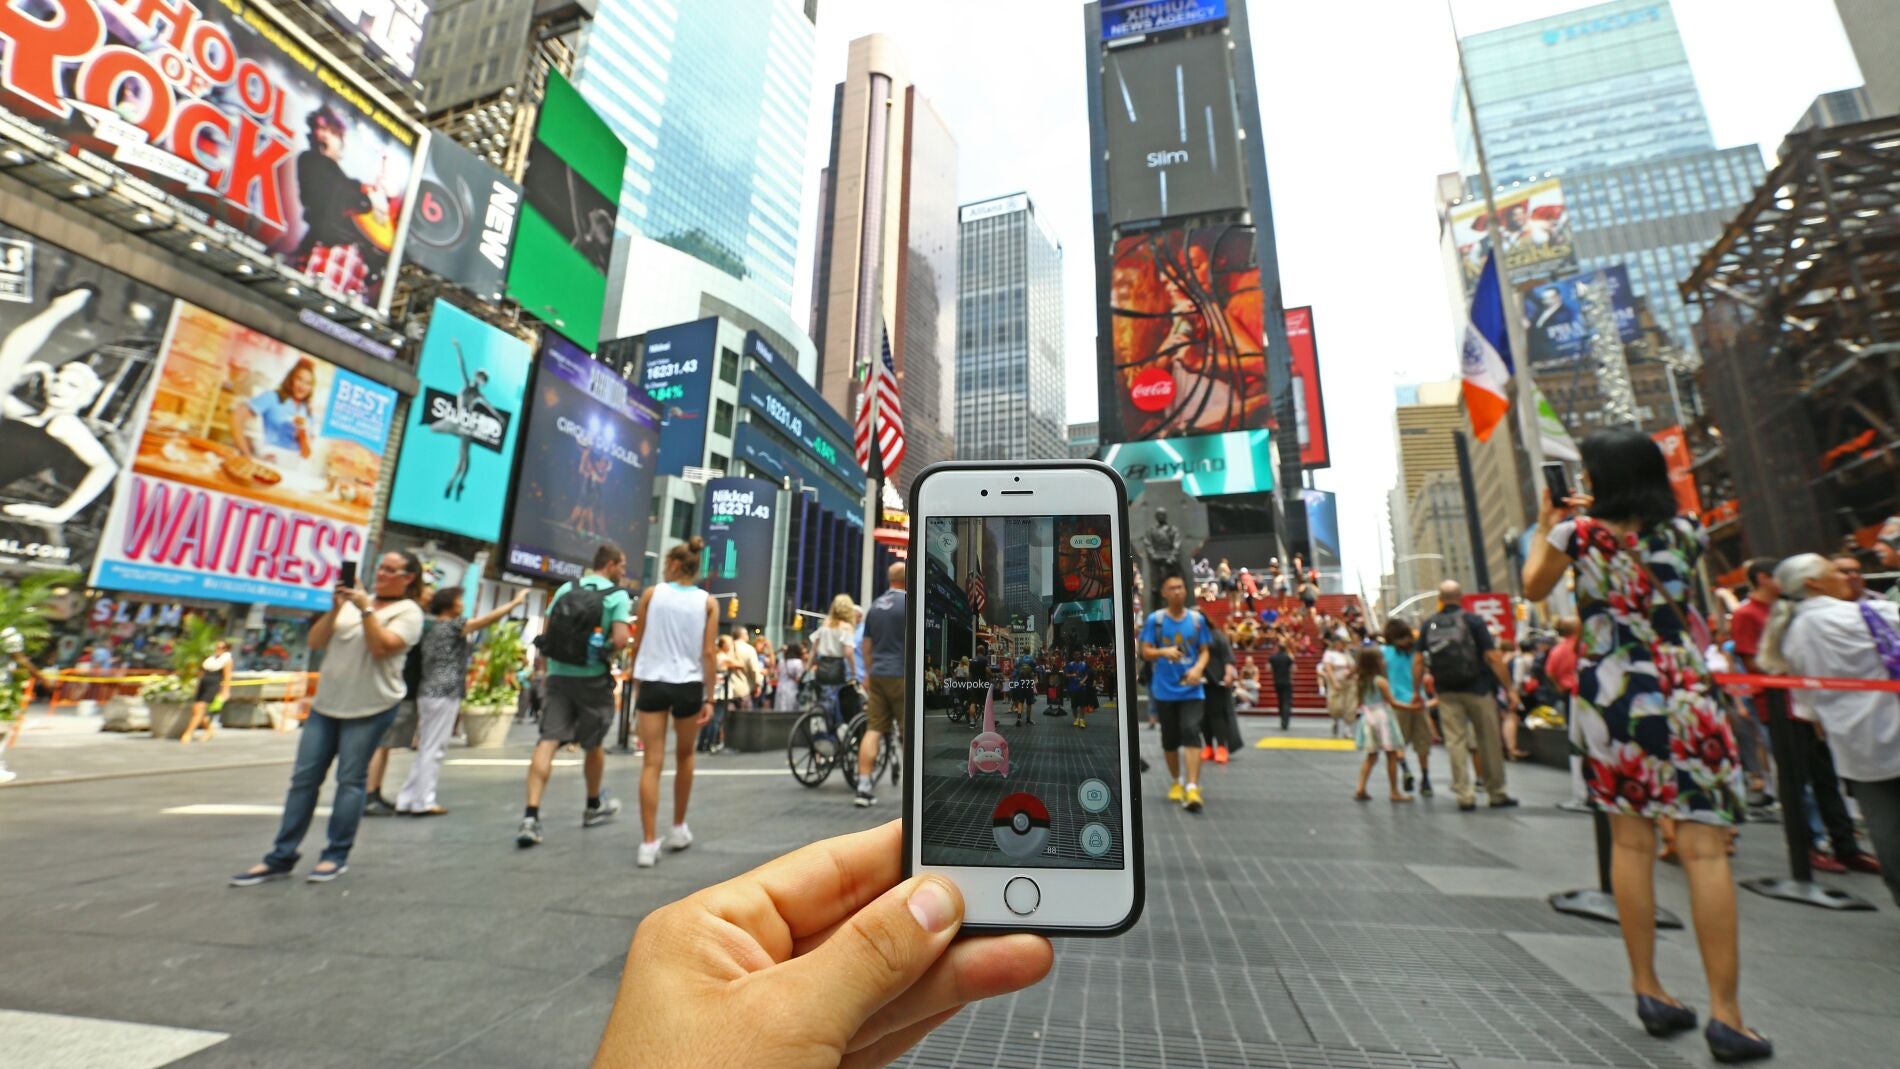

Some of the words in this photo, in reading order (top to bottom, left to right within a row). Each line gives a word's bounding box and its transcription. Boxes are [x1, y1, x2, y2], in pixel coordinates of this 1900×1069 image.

[1110, 17, 1153, 36] NEWS
[1153, 5, 1215, 28] AGENCY
[479, 179, 519, 270] NEW
[646, 359, 699, 380] 16231.43
[336, 378, 391, 416] BEST
[765, 394, 803, 438] 16231.43
[712, 489, 755, 505] Nikkei
[712, 502, 770, 520] 16231.43
[125, 477, 361, 588] WAITRESS
[93, 596, 183, 627] SLAM
[943, 678, 991, 691] Slowpoke
